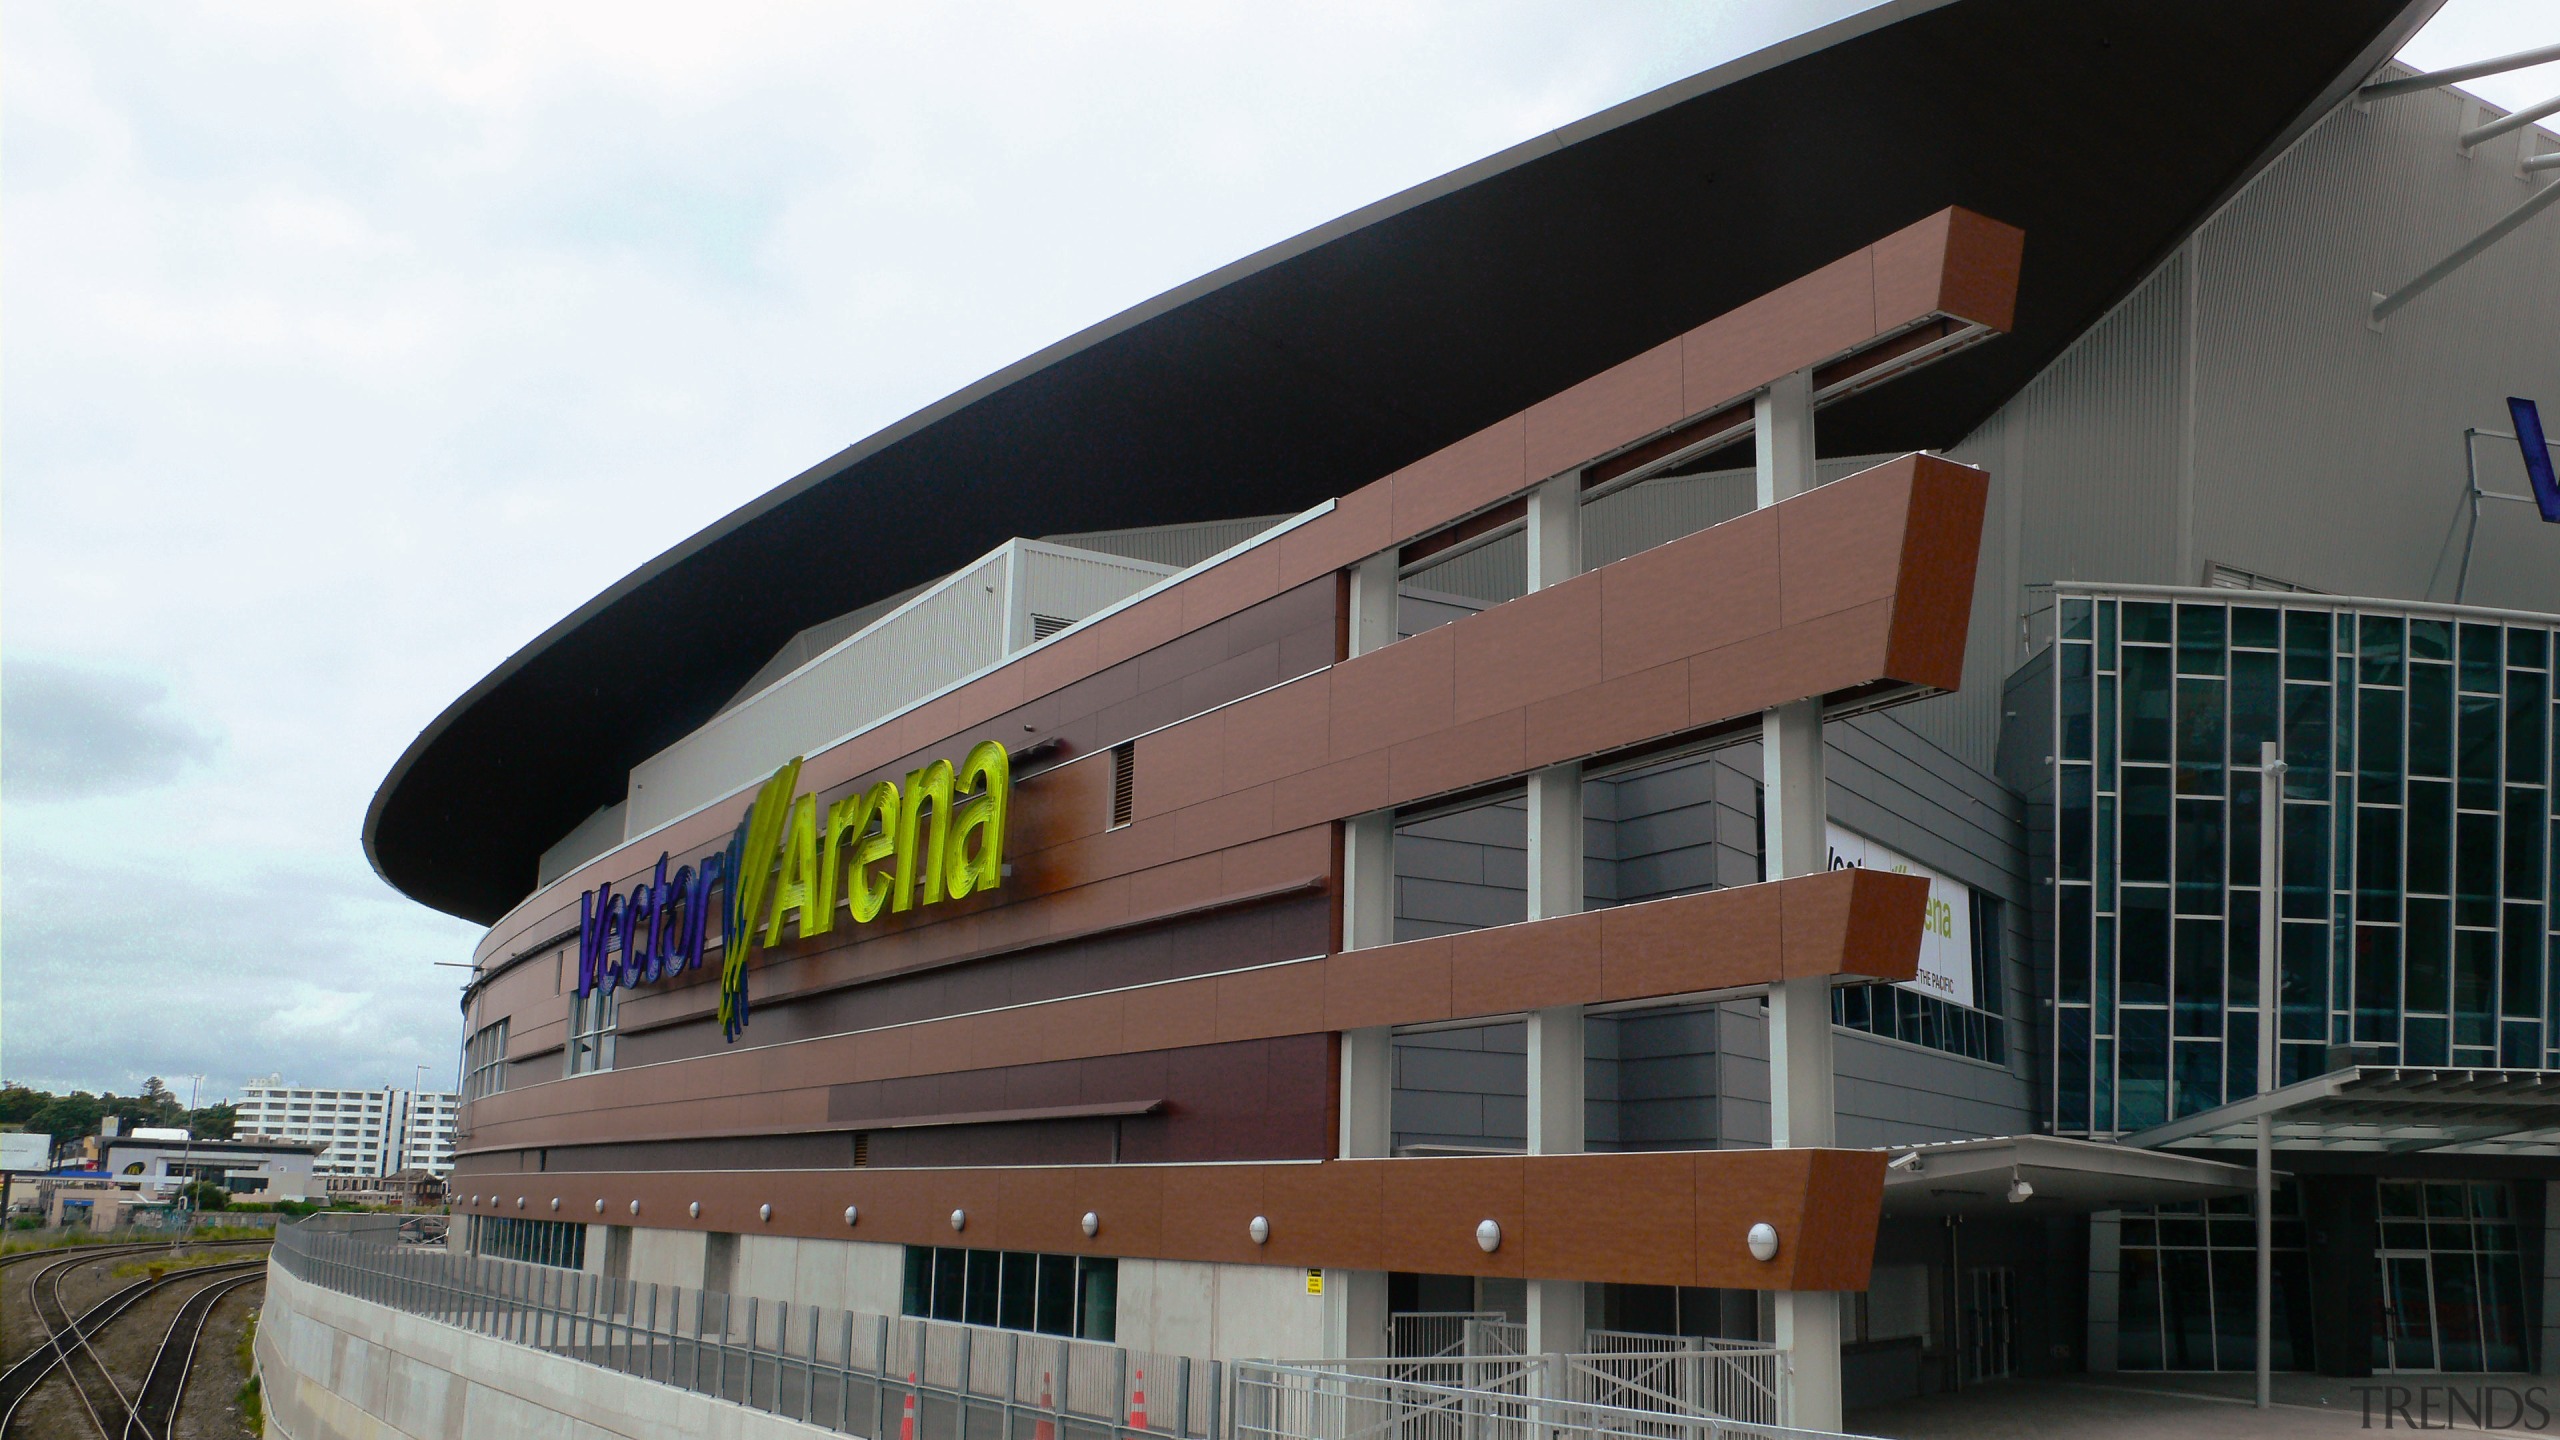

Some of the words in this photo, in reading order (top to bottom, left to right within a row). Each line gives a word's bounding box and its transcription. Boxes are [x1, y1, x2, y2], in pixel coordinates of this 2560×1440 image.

[578, 851, 724, 1000] Vector
[763, 740, 1009, 948] Arena
[1919, 968, 1931, 987] THE
[1932, 973, 1954, 994] PACIFIC
